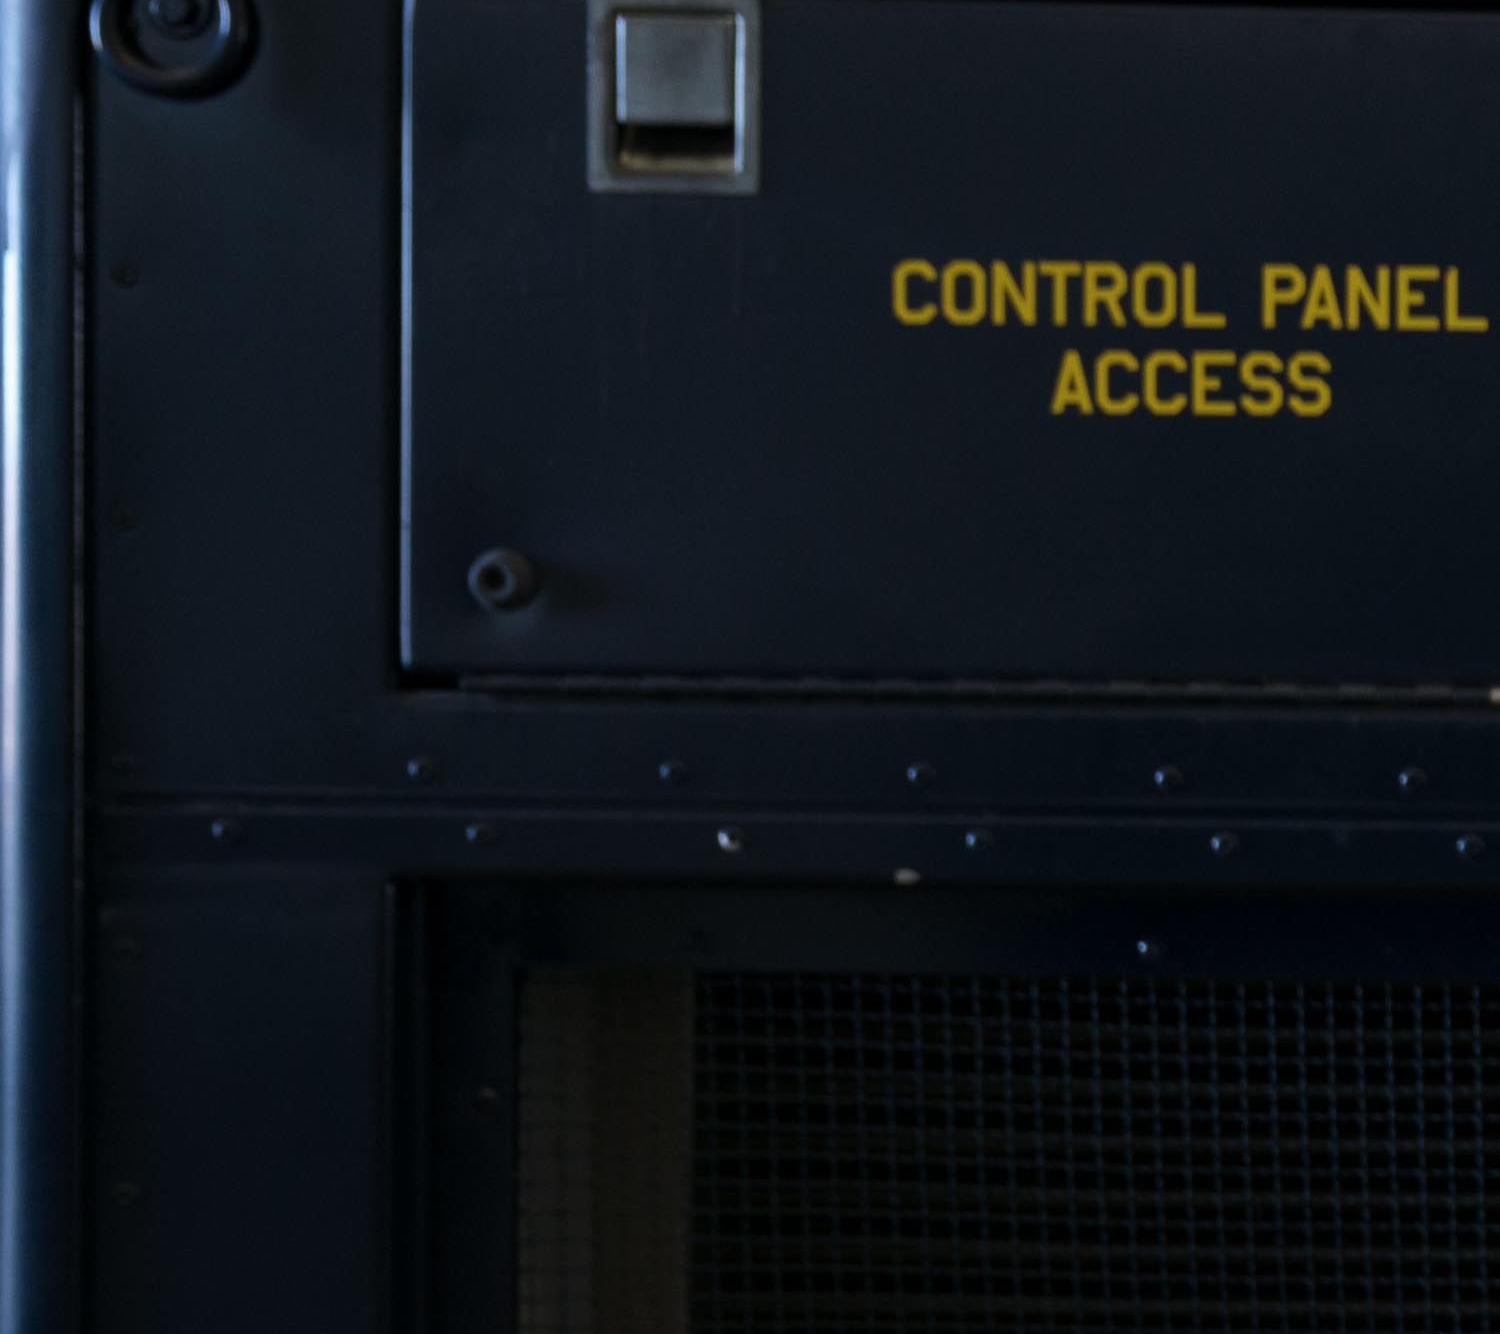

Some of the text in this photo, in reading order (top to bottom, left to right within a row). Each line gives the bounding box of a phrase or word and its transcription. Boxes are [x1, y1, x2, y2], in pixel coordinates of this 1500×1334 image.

[893, 260, 1488, 331] CONTROL PANEL
[1051, 349, 1332, 416] ACCESS
